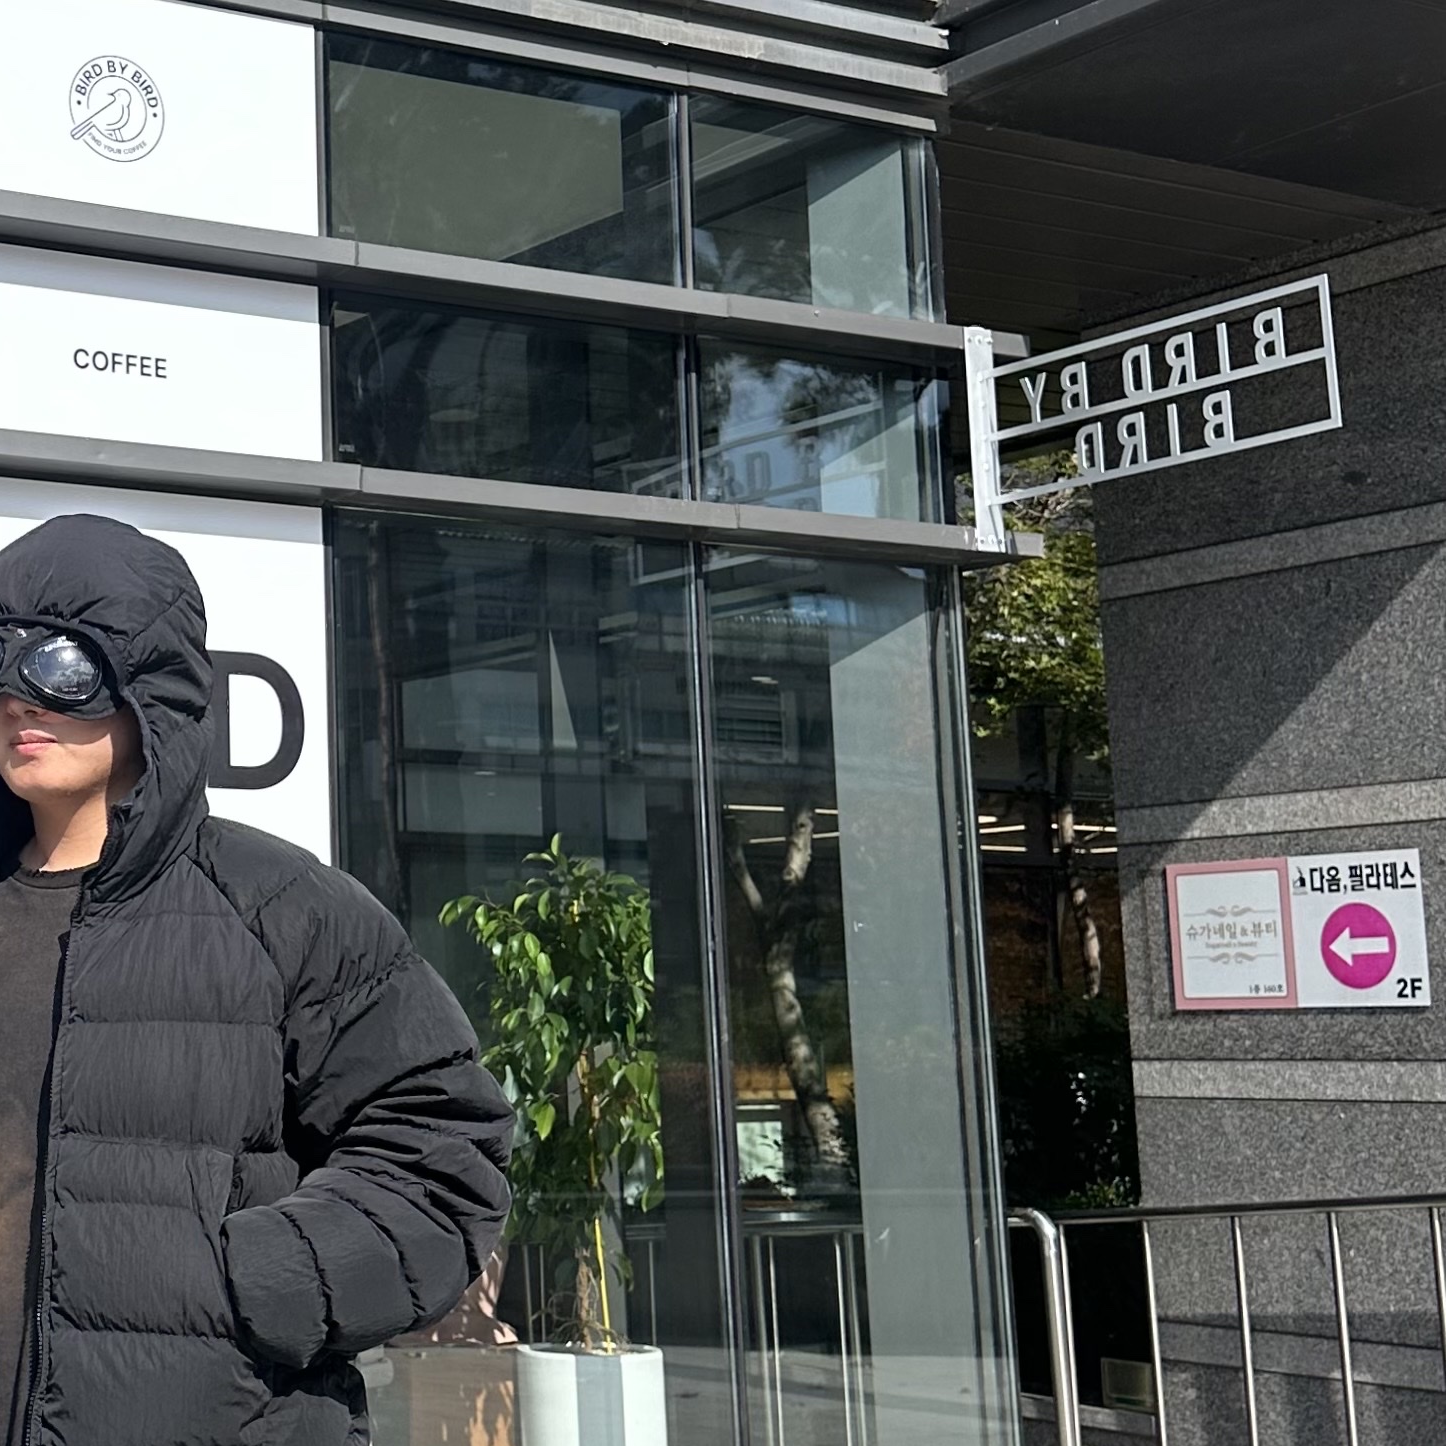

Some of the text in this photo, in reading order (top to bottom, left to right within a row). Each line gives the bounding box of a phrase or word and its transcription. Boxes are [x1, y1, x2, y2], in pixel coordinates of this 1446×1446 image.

[75, 60, 159, 108] BIRD BY BIRD
[73, 348, 167, 379] COFFEE
[1396, 977, 1423, 999] 2F
